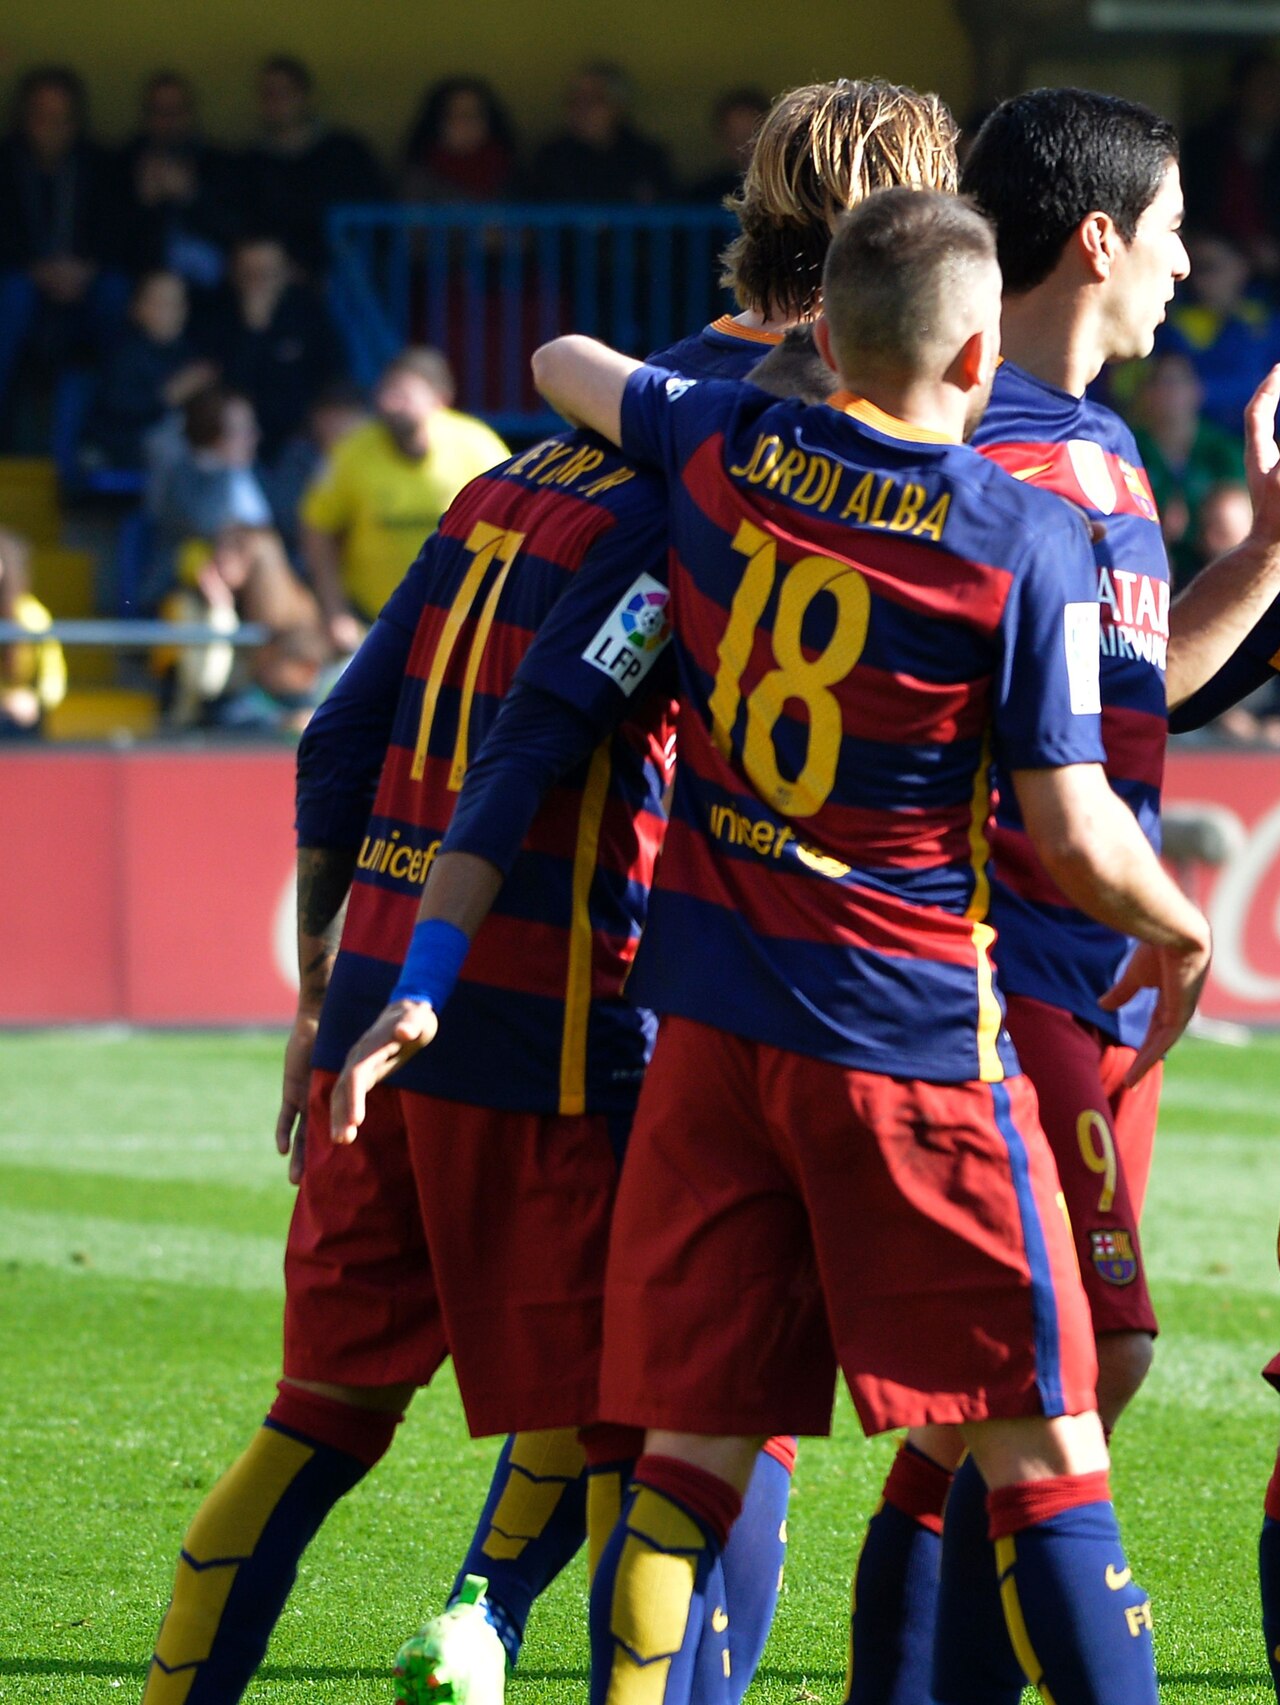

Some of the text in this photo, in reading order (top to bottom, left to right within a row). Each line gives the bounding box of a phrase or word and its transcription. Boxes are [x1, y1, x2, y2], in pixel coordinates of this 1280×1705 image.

[729, 433, 951, 541] JORDI ALBA
[409, 520, 526, 791] 11
[594, 636, 643, 681] LFP
[707, 518, 870, 817] 18
[356, 829, 442, 884] unicef
[1076, 1109, 1117, 1212] 9
